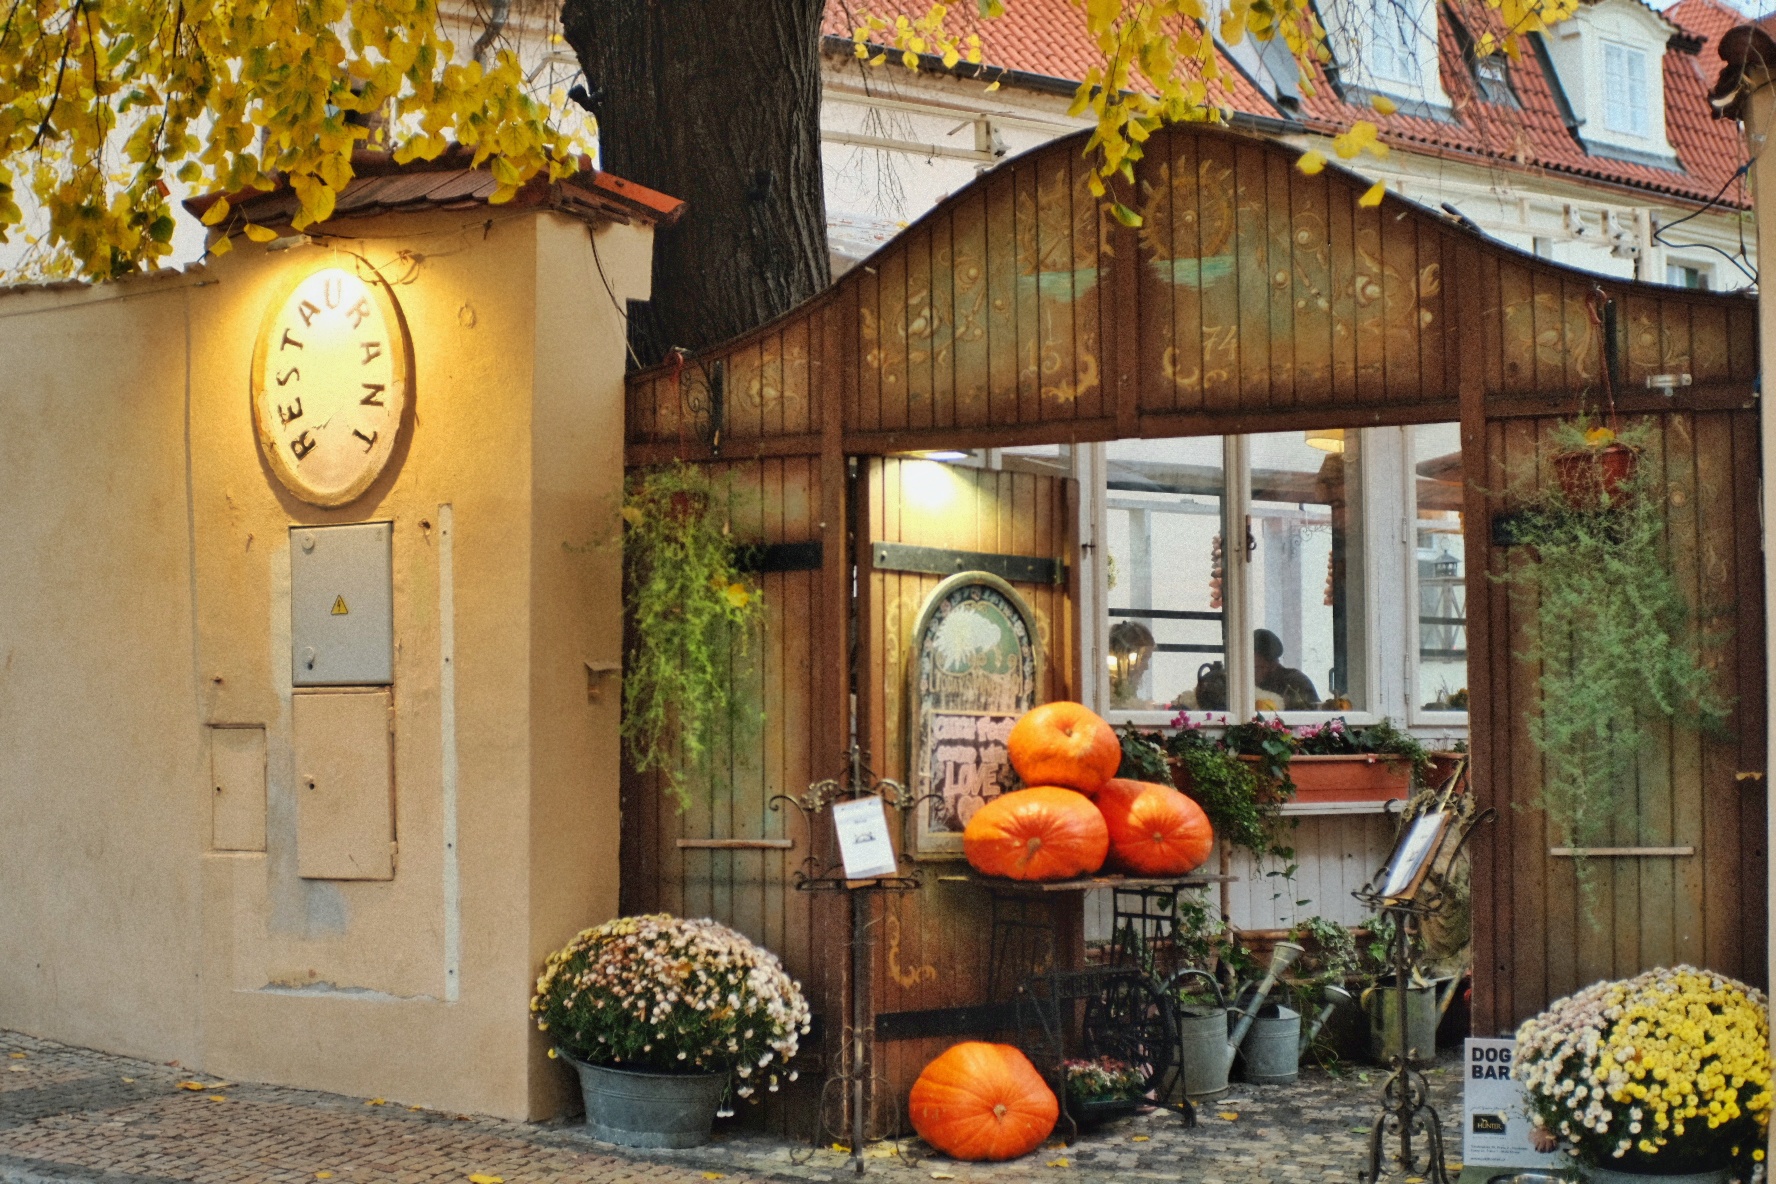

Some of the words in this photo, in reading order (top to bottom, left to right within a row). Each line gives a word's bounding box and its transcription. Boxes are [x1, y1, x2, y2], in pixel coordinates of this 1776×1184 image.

[1202, 325, 1237, 361] 74
[276, 277, 386, 461] RESTAURANT
[943, 761, 1001, 797] LOVE
[1471, 1047, 1512, 1063] DOG
[1471, 1065, 1511, 1080] BAR
[1477, 1122, 1502, 1130] HUNTER
